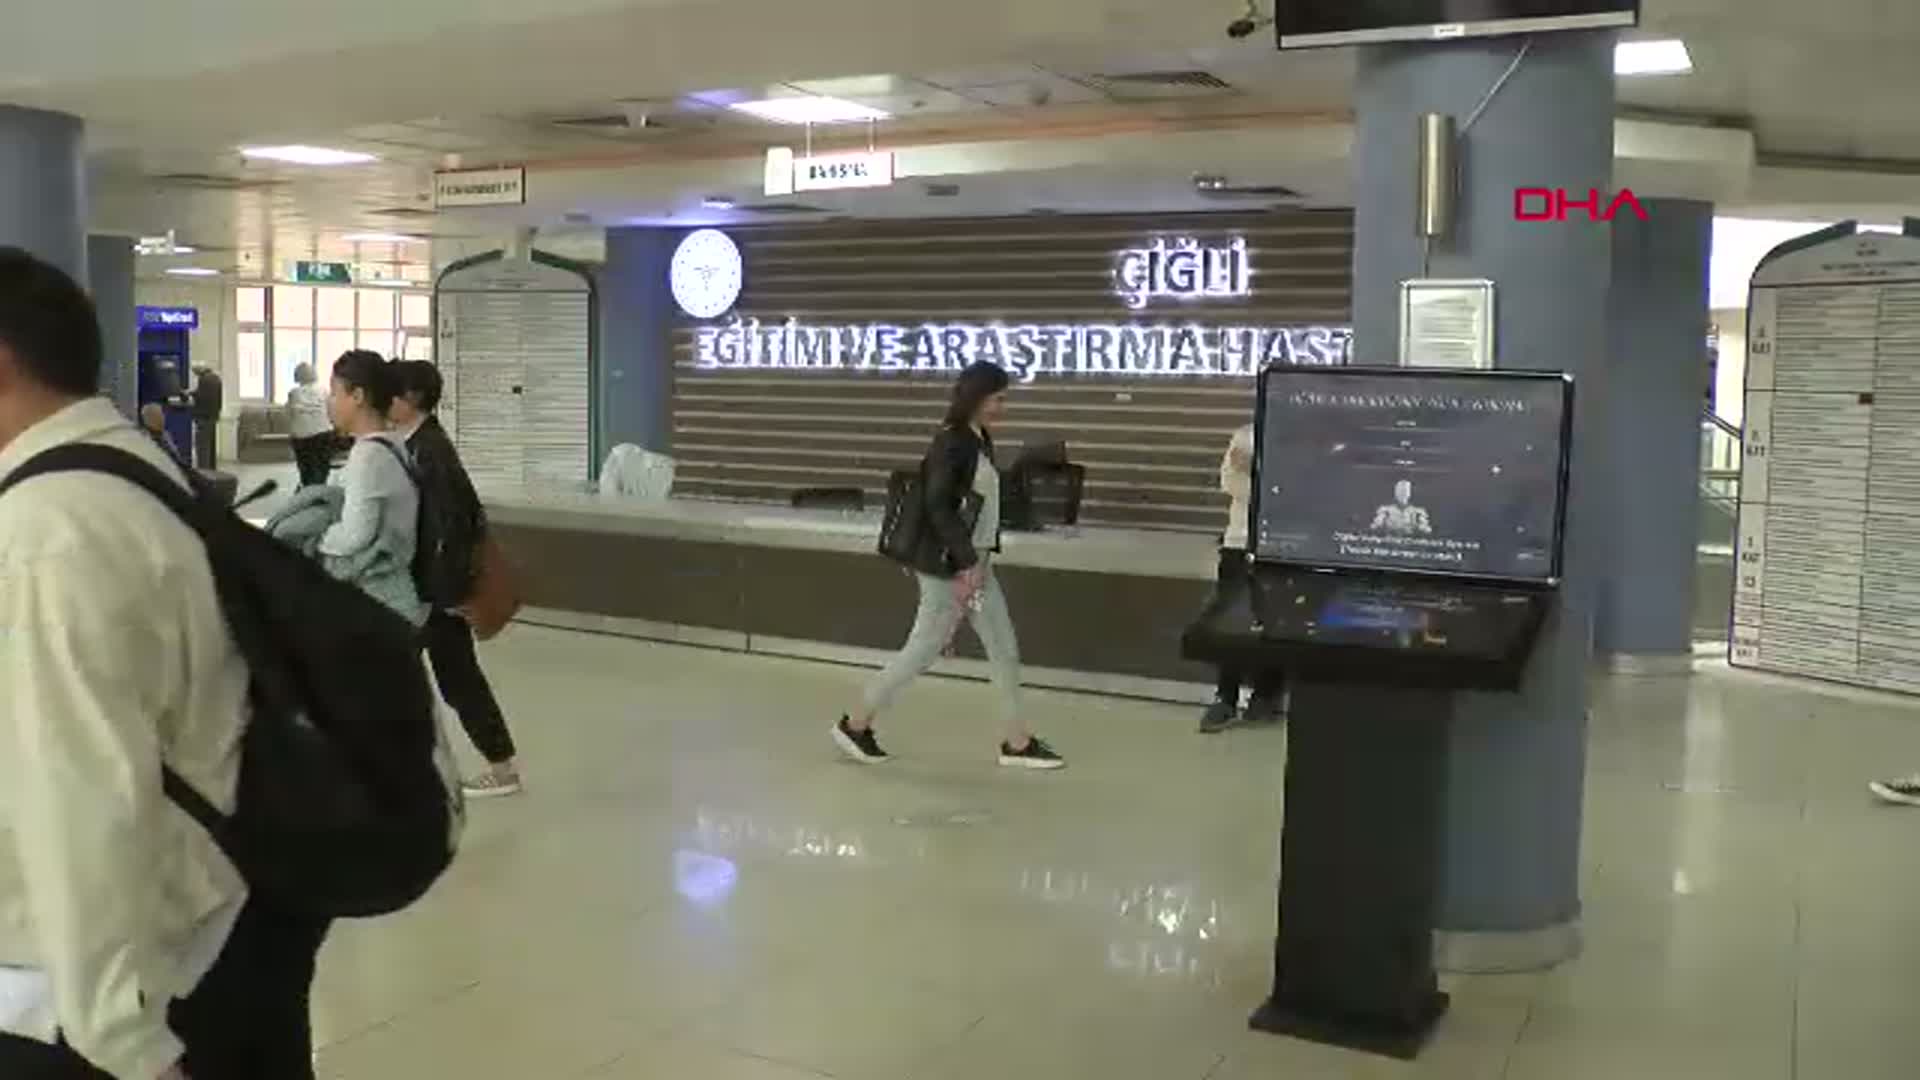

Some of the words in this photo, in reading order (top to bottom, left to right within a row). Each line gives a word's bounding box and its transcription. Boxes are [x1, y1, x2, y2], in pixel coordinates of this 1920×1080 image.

[1112, 237, 1249, 308] ÇİĞLİ
[845, 325, 903, 370] VE
[908, 323, 1208, 383] ARAŞTIRMA
